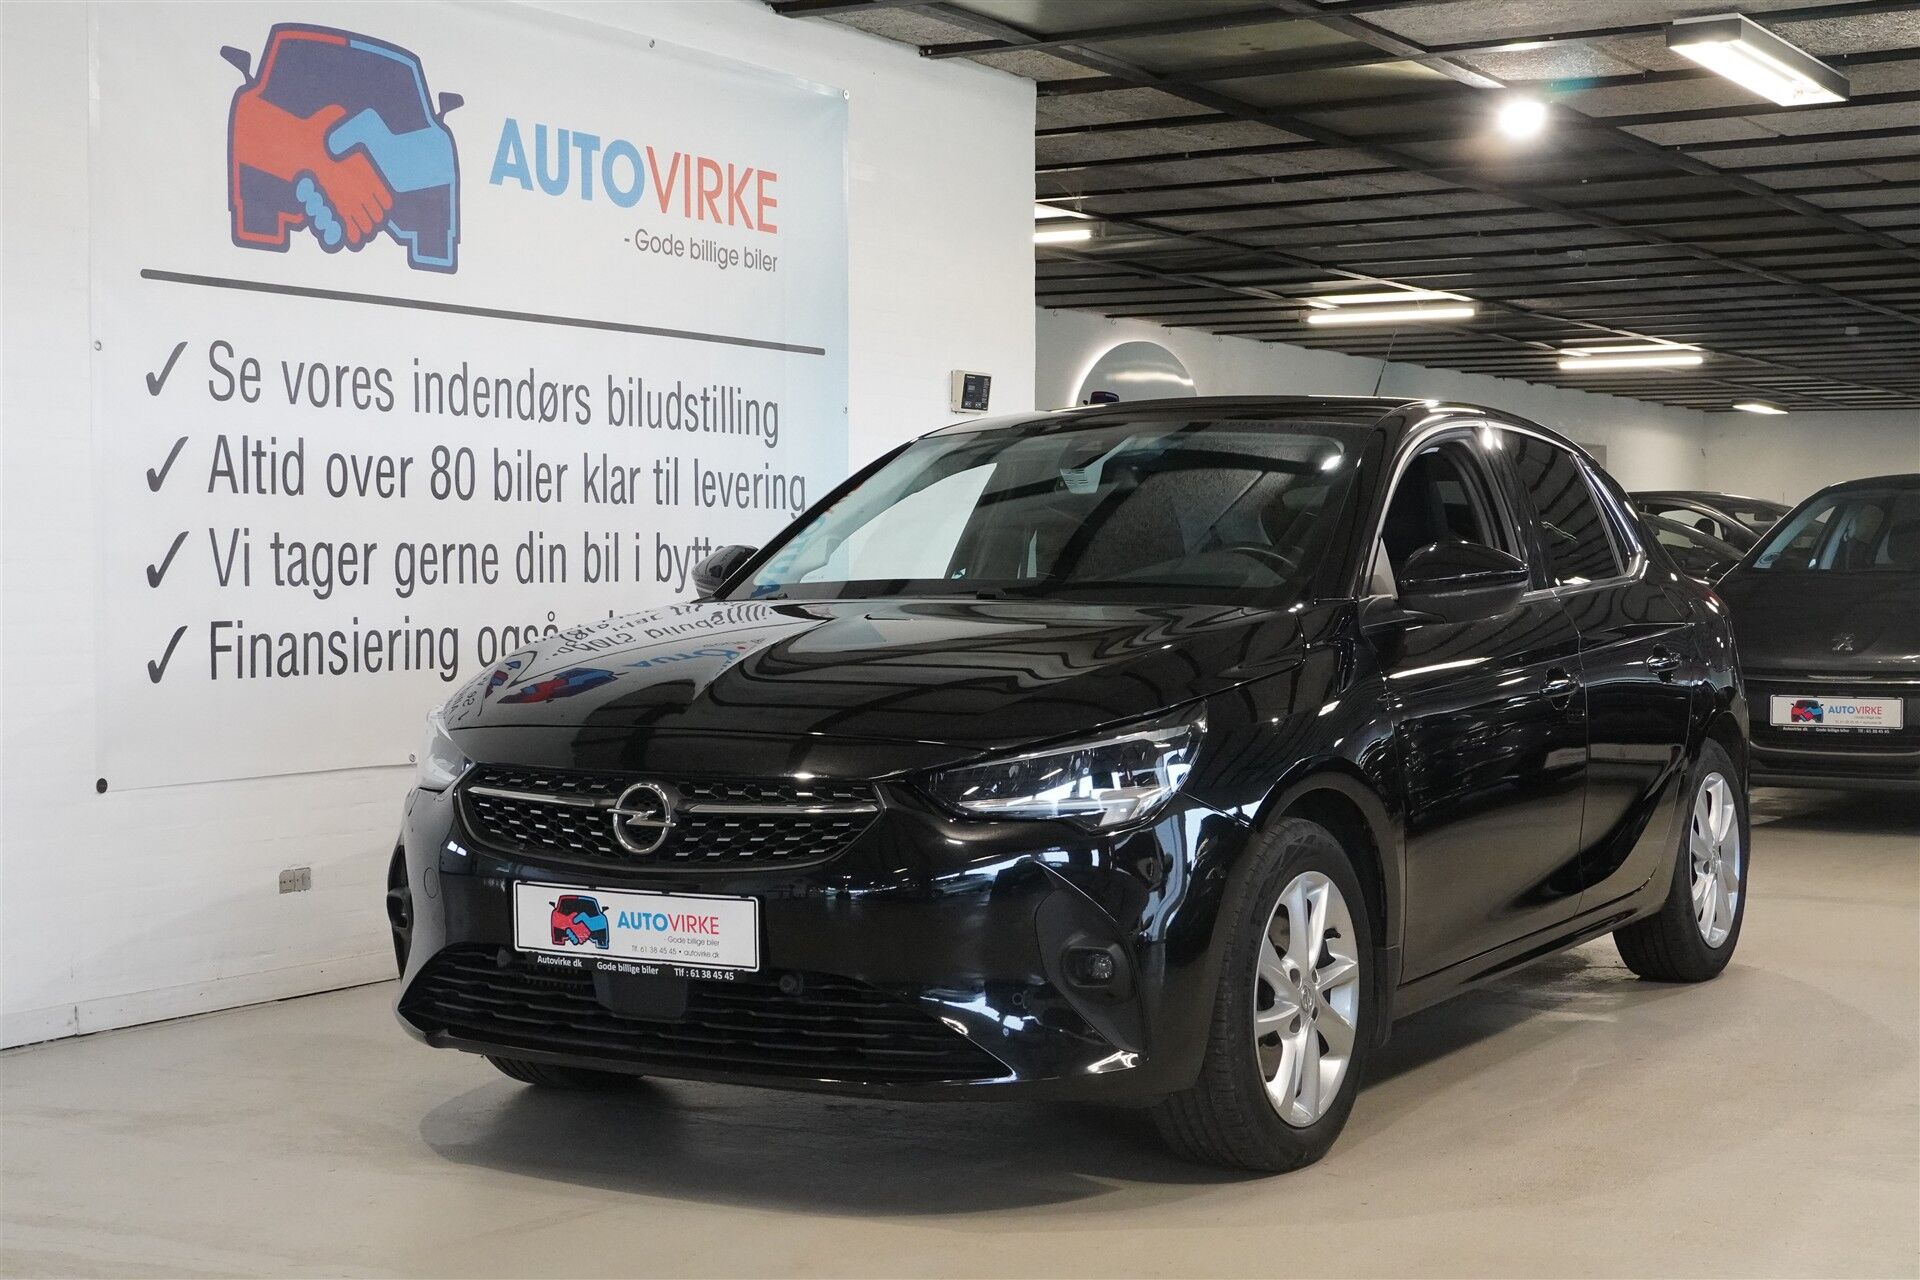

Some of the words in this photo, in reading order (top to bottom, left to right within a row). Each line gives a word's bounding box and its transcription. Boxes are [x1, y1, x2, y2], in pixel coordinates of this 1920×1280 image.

[490, 118, 777, 234] AUTOVIRKE
[635, 229, 684, 258] Gode
[691, 238, 739, 270] billige
[745, 247, 778, 272] biler
[208, 340, 261, 403] Se
[282, 361, 395, 412] vores
[413, 358, 592, 425] indendørs
[608, 375, 779, 449] biludstilling
[208, 435, 304, 497] Altid
[326, 453, 413, 499] over
[430, 445, 476, 502] 80
[494, 448, 568, 504] biler
[583, 455, 641, 505] klar
[653, 460, 679, 506] til
[695, 465, 807, 519] levering
[209, 528, 250, 587] Vi
[270, 532, 378, 600] tager
[395, 539, 499, 597] gerne
[516, 531, 567, 585] din
[583, 532, 619, 584] bil
[635, 533, 640, 582] i
[656, 532, 725, 593] bytt
[210, 616, 459, 682] Finansiering
[1828, 706, 1882, 715] AUTOVIRKE
[617, 911, 720, 935] AUTOVIRKE
[667, 936, 686, 944] Gode
[687, 937, 705, 947] billige
[707, 938, 720, 946] biler
[537, 955, 572, 967] Autovirke
[573, 958, 583, 968] dk
[597, 961, 616, 971] Gode
[618, 963, 640, 974] billige
[642, 966, 659, 975] biler
[690, 970, 699, 978] 61
[701, 971, 711, 979] 38
[713, 971, 723, 980] 45
[724, 972, 735, 981] 45
[649, 946, 658, 954] 38
